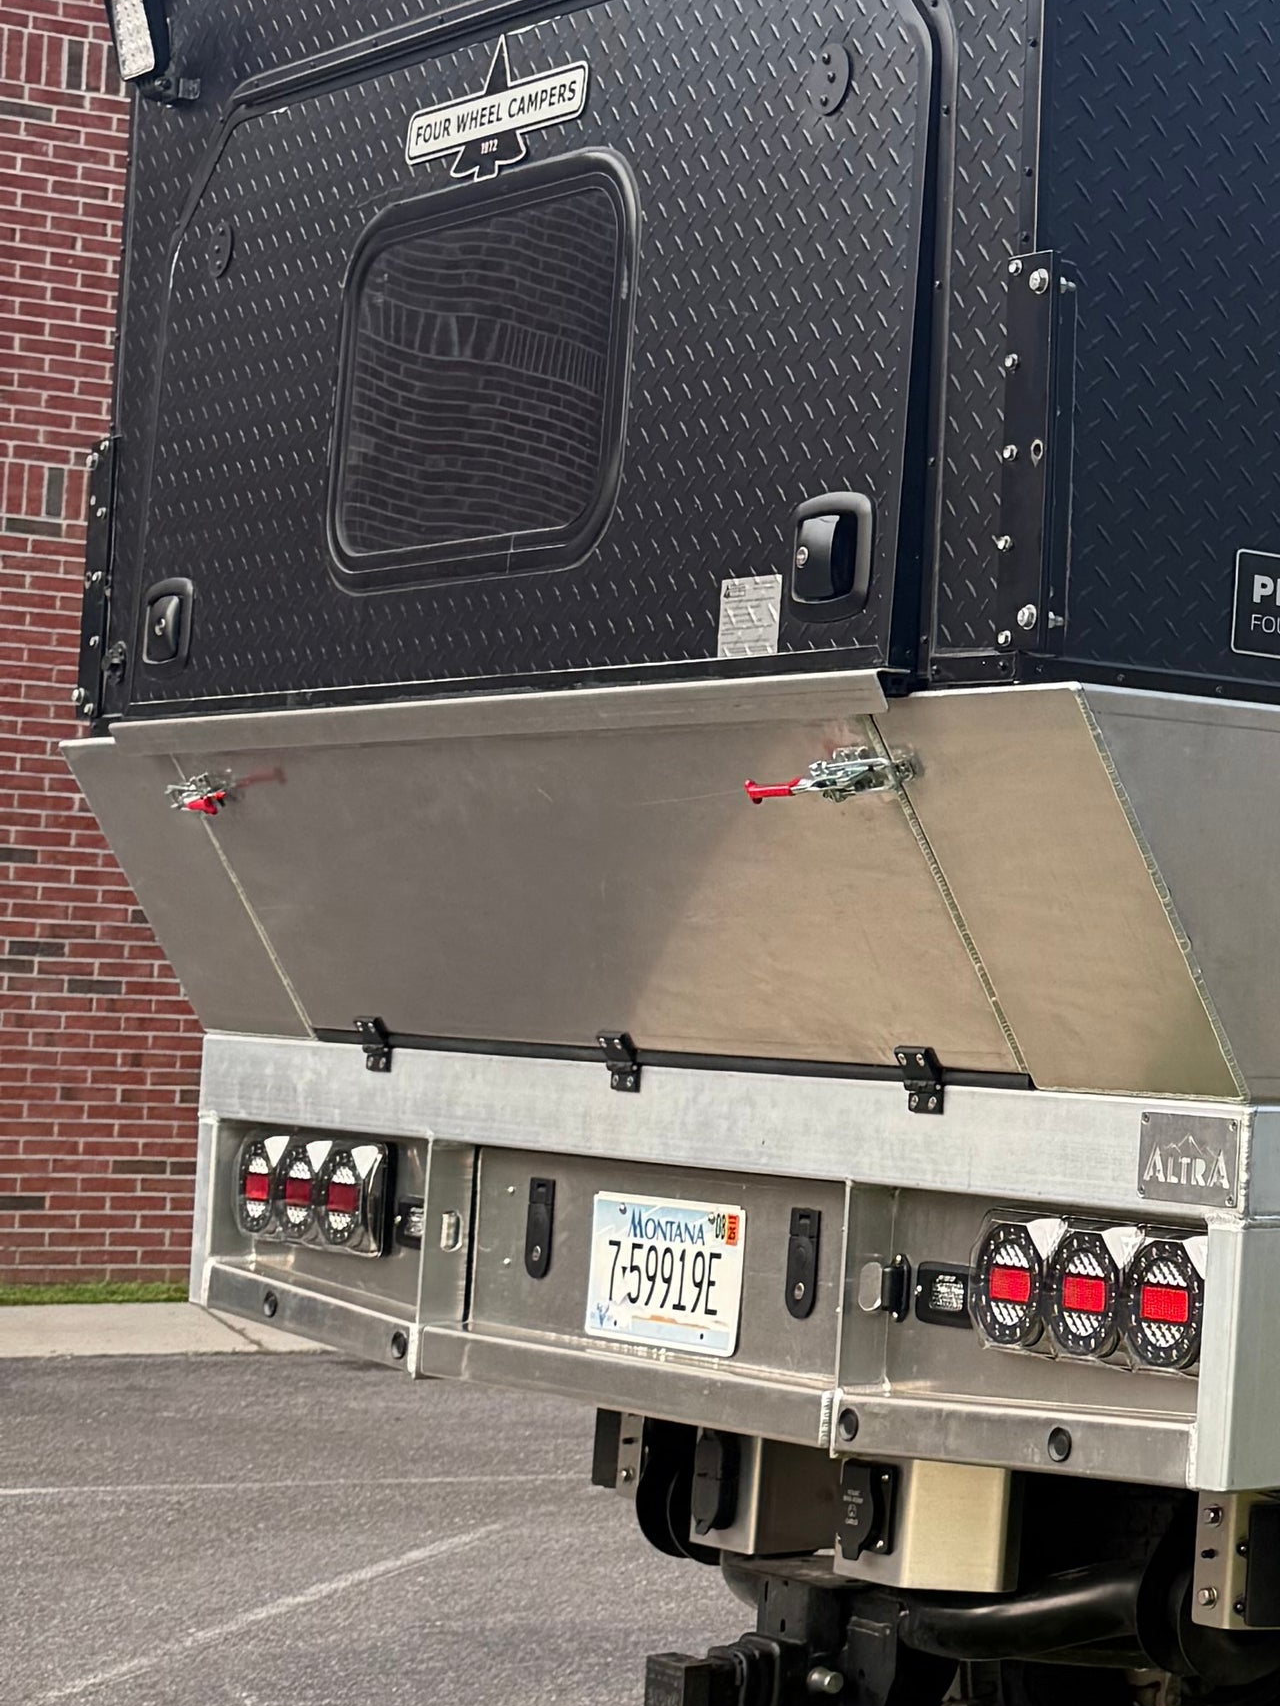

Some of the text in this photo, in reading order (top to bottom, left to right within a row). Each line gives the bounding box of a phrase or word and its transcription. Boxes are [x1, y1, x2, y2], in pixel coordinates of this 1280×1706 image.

[415, 80, 577, 146] FOUR WHEEL CAMPERS
[1143, 1141, 1230, 1190] ALTRA
